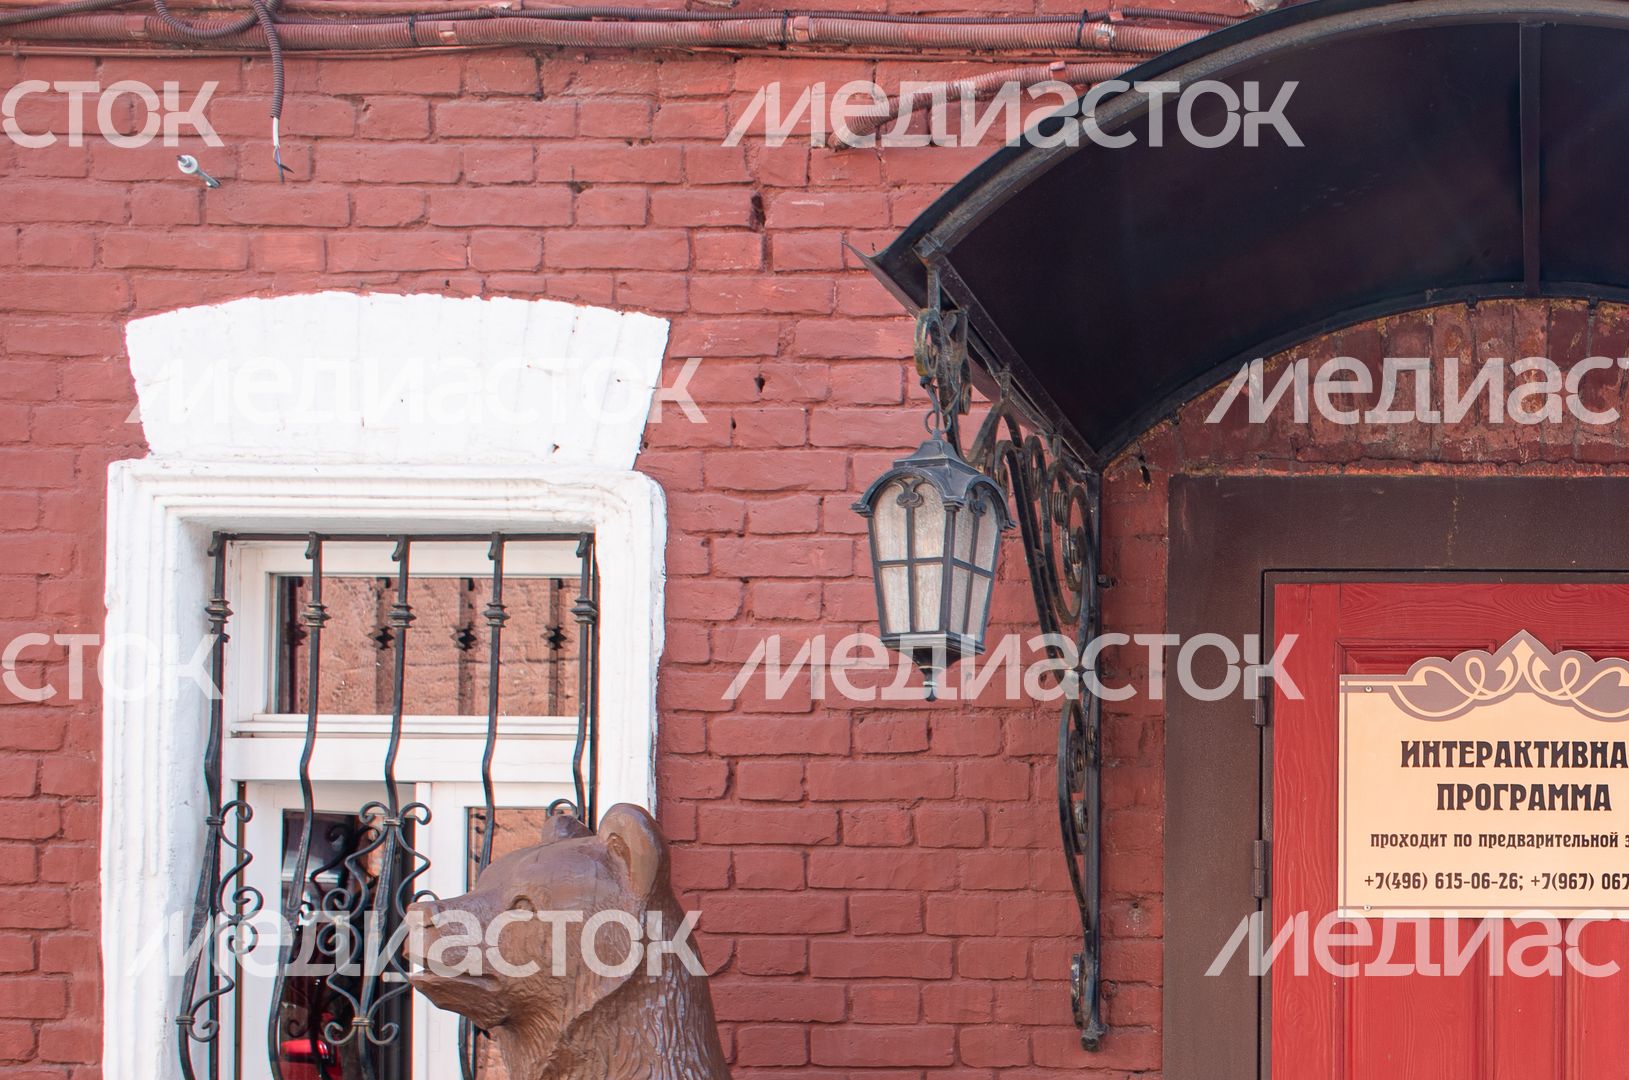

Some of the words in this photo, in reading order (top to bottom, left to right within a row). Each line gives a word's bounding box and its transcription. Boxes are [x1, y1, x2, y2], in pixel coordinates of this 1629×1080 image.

[1436, 783, 1612, 812] ПРОГРАММА
[1370, 833, 1448, 849] проходит
[1453, 833, 1473, 848] по
[1478, 831, 1619, 849] предварительной
[1364, 872, 1428, 891] +7(496)
[1435, 872, 1524, 892] 615-06-26;
[1530, 872, 1595, 892] +7(967)
